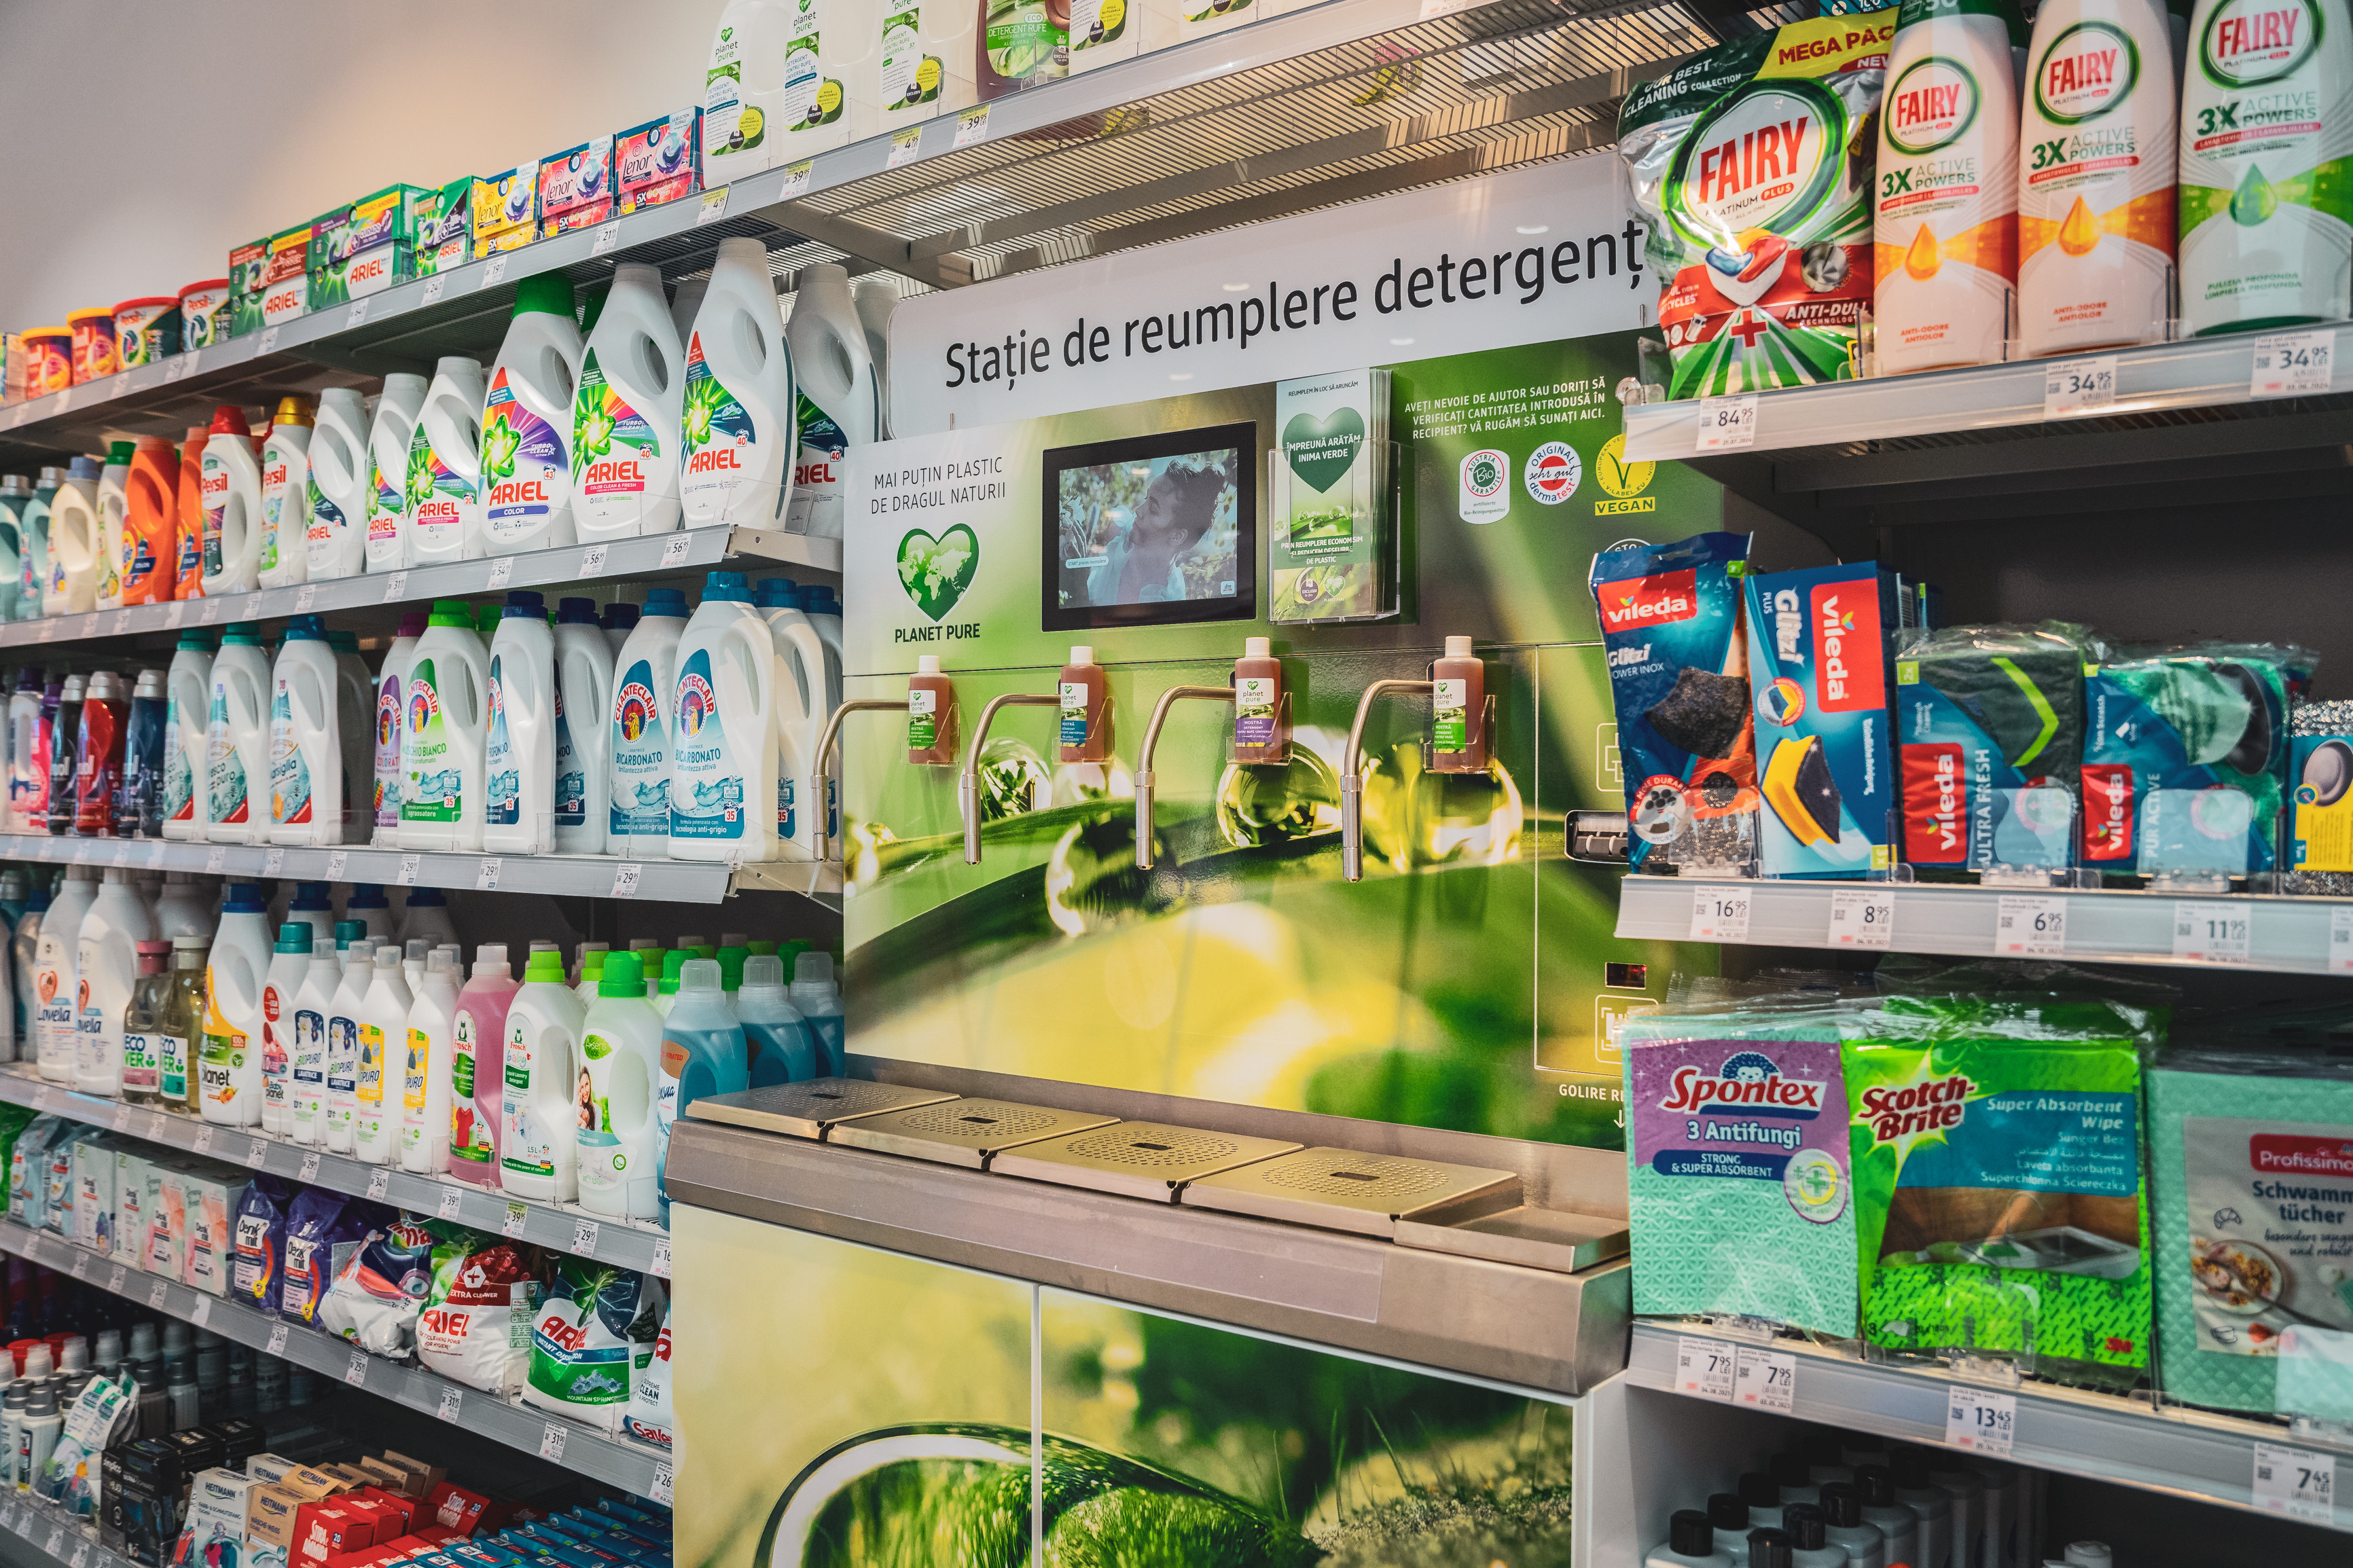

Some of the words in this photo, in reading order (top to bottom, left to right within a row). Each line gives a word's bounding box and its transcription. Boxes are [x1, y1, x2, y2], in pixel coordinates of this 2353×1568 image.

[793, 11, 816, 27] planet
[796, 22, 812, 35] pure
[988, 26, 1027, 38] DETERGENT
[1028, 24, 1047, 33] RUFE
[2217, 7, 2299, 59] FAIRY
[715, 41, 738, 56] planet
[717, 50, 734, 64] pure
[1778, 37, 1842, 65] MEGA
[786, 54, 808, 67] DETERGENT
[1645, 73, 1674, 92] OUR
[1675, 58, 1712, 80] BEST
[2047, 48, 2117, 96] FAIRY
[708, 82, 730, 94] DETERGENT
[1624, 83, 1687, 118] CLEANING
[1691, 73, 1741, 91] COLLECTION
[1895, 84, 1961, 128] FAIRY
[2196, 101, 2242, 136] 3X
[2243, 91, 2317, 113] ACTIVE
[967, 117, 980, 130] 39
[2242, 106, 2317, 127] POWERS
[2030, 138, 2067, 170] 3X
[2070, 127, 2135, 146] ACTIVE
[2069, 141, 2136, 162] POWERS
[1697, 116, 1808, 206] FAIRY
[1881, 169, 1913, 198] 3X
[1915, 158, 1975, 177] ACTIVE
[1915, 171, 1976, 191] POWERS
[1763, 183, 1792, 199] PLUS
[439, 242, 461, 259] ARIEL
[350, 259, 384, 285] ARIEL
[264, 291, 299, 316] ARIEL
[946, 329, 1050, 391] Stație
[1062, 318, 1109, 367] de
[1125, 280, 1358, 359] reumplere
[1373, 219, 1644, 313] detergenț
[1785, 302, 1869, 320] ANTI-DULL
[1289, 388, 1312, 397] REUMPLEM
[1335, 380, 1359, 390] ARUNCĂM
[1405, 401, 1431, 414] AVEȚI
[1434, 397, 1470, 409] NEVOIE
[1473, 394, 1486, 403] DE
[1489, 388, 1526, 402] AJUTOR
[1530, 386, 1549, 397] SAU
[1553, 380, 1589, 395] DORIȚI
[1592, 376, 1605, 389] SĂ
[1413, 410, 1465, 426] VERIFICAȚI
[1468, 403, 1527, 419] CANTITATEA
[1530, 393, 1590, 411] INTRODUSĂ
[1593, 392, 1605, 403] ÎN
[1719, 410, 1739, 426] 84
[1413, 424, 1467, 439] RECIPIENT?
[1470, 420, 1482, 433] VĂ
[1485, 416, 1520, 431] RUGĂM
[1524, 413, 1537, 426] SĂ
[1540, 411, 1577, 426] SUNAȚI
[1580, 407, 1605, 419] AICI.
[736, 436, 746, 445] 40
[1287, 437, 1327, 452] ÎMPREUNĂ
[1328, 434, 1361, 447] ARĂTĂM
[641, 450, 651, 459] 40
[689, 449, 741, 474] ARIEL
[1298, 452, 1321, 462] INIMA
[1322, 448, 1348, 460] VERDE
[1468, 454, 1496, 472] AUSTRIA
[1531, 445, 1575, 467] ORIGINAL
[545, 471, 554, 480] 43
[585, 461, 645, 484] ARIEL
[874, 468, 897, 490] MAI
[902, 464, 942, 491] PUȚIN
[948, 457, 1003, 478] PLASTIC
[1475, 467, 1494, 483] Bio
[1529, 468, 1551, 480] sehr
[1553, 464, 1581, 481] gut
[489, 481, 549, 506] ARIEL
[872, 498, 887, 514] DE
[892, 490, 946, 512] DRAGUL
[951, 481, 1005, 504] NATURII
[1530, 481, 1576, 503] dermatest
[418, 503, 460, 517] ARIEL
[503, 507, 525, 516] COLOR
[1596, 498, 1653, 513] VEGAN
[672, 542, 683, 553] 56
[1296, 539, 1327, 548] REUMPLERE
[1314, 555, 1336, 564] PLASTIC
[1607, 597, 1688, 623] vileda
[1762, 591, 1772, 614] PLUS
[895, 624, 942, 644] PLANET
[946, 623, 980, 640] PURE
[1774, 585, 1805, 668] Glitzi
[1822, 595, 1848, 701] vileda
[1639, 662, 1664, 675] INOX
[615, 684, 656, 721] CHANTECLAIR
[421, 743, 446, 755] BIANCO
[675, 747, 721, 762] BICARBONATO
[616, 750, 662, 767] BICARBONATO
[1977, 749, 1990, 804] FRESH
[1935, 754, 1958, 850] vileda
[726, 809, 735, 822] 35
[2107, 773, 2123, 851] vileda
[1716, 900, 1733, 917] 16
[510, 1041, 526, 1051] Frosch
[507, 1050, 526, 1068] baby
[1559, 1084, 1606, 1100] GOLIRE
[1664, 1069, 1818, 1111] Spontex
[1988, 1099, 2032, 1113] Super
[2036, 1099, 2122, 1113] Absorbent
[1871, 1103, 1962, 1142] Brite
[2081, 1116, 2123, 1130] Wipe
[1688, 1121, 1700, 1139] 3
[1706, 1122, 1801, 1150] Antifungi
[1701, 1154, 1740, 1164] STRONG
[1672, 1163, 1679, 1173] &
[1681, 1163, 1713, 1173] SUPER
[1714, 1165, 1772, 1177] ABSORBENT
[2279, 1203, 2345, 1224] tücher
[582, 1228, 590, 1241] 29
[450, 1290, 472, 1298] EXTRA
[2106, 1337, 2132, 1353] 3M
[640, 1385, 659, 1400] CLEAN
[1975, 1406, 1995, 1427] 13
[205, 1482, 236, 1500] HEITMANN
[260, 1495, 288, 1514] HEITMANN
